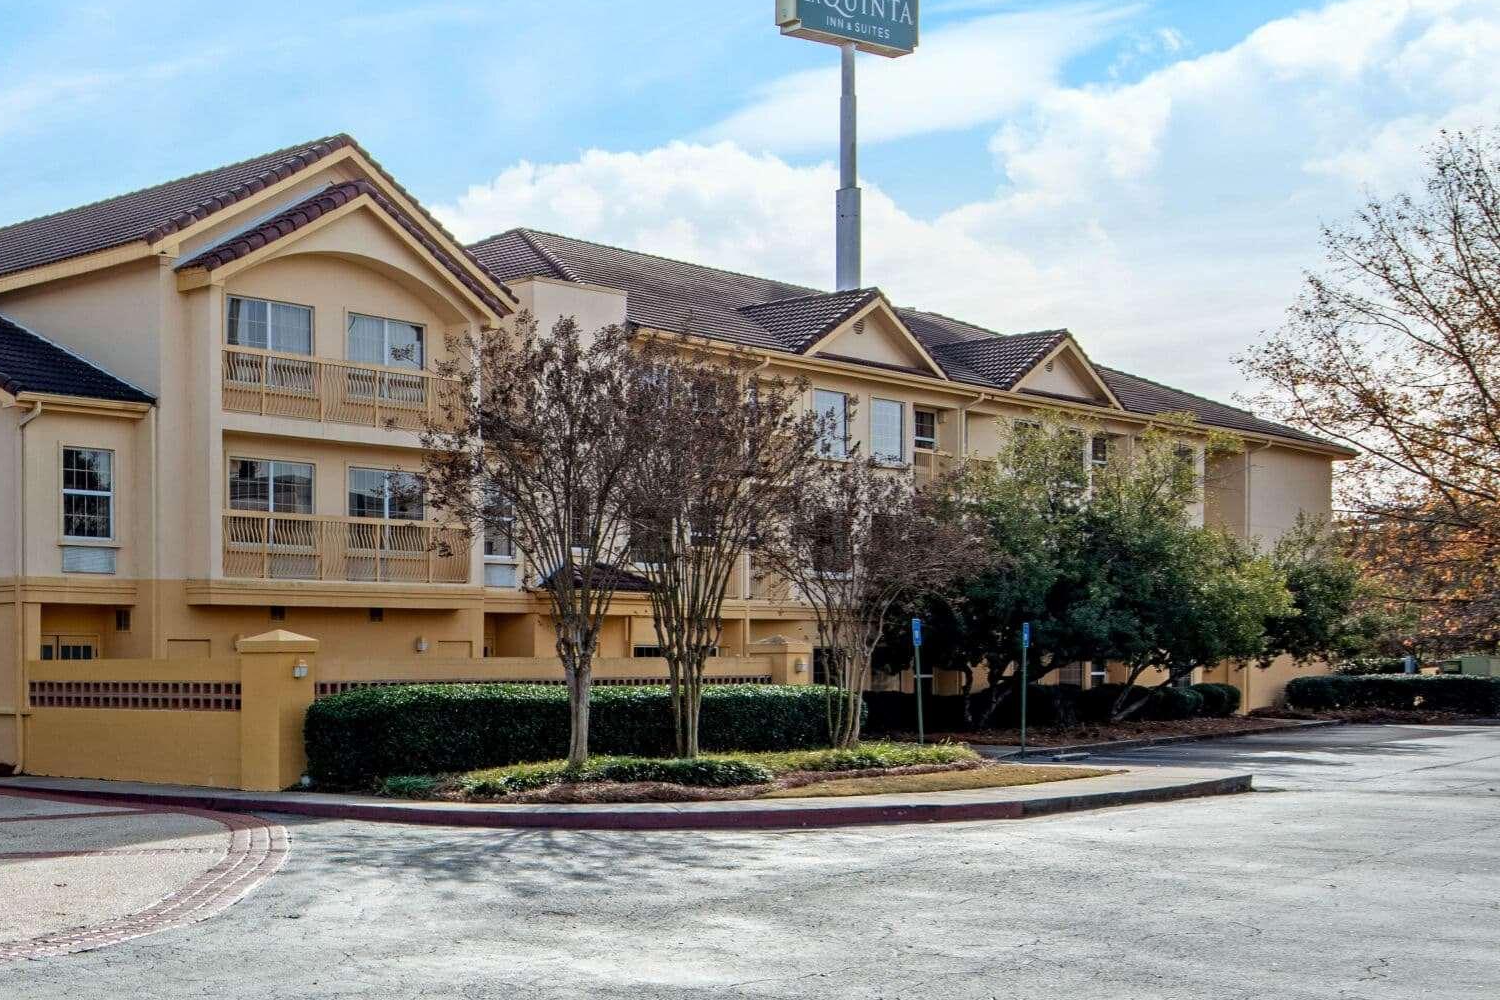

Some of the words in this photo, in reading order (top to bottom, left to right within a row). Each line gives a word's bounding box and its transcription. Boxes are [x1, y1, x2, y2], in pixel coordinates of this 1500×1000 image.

[826, 16, 844, 29] INN
[846, 22, 852, 30] &
[854, 22, 891, 39] SUITES
